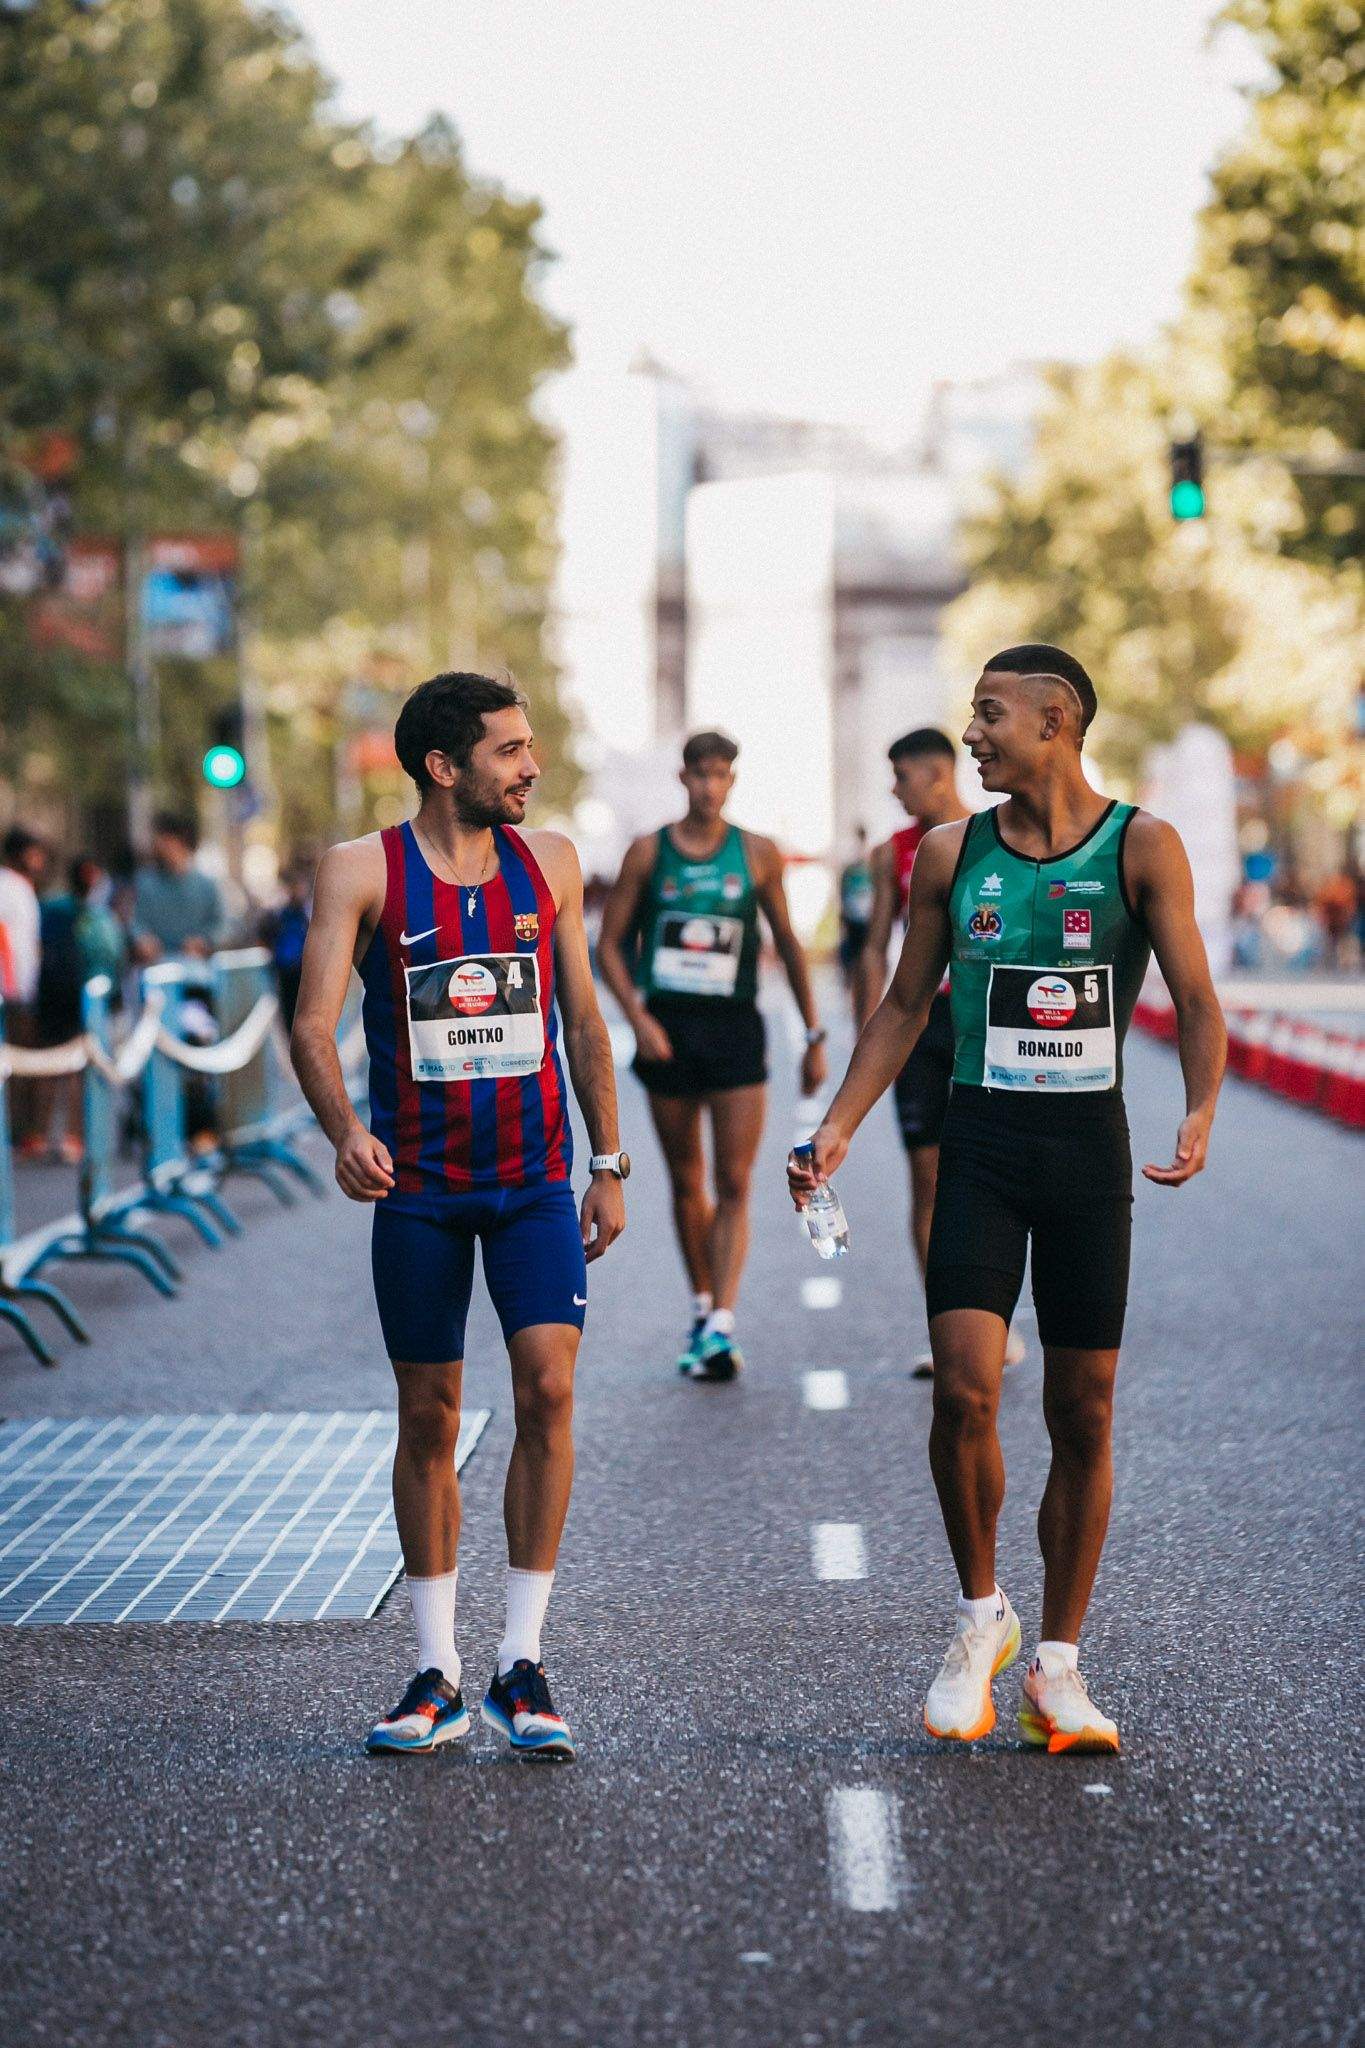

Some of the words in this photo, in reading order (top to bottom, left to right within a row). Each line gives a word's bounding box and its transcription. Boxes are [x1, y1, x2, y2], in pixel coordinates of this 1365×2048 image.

[507, 961, 523, 988] 4
[1084, 974, 1099, 1003] 5
[448, 1027, 504, 1046] GONTXO
[1018, 1041, 1083, 1058] RONALDO
[427, 1064, 456, 1072] MADID
